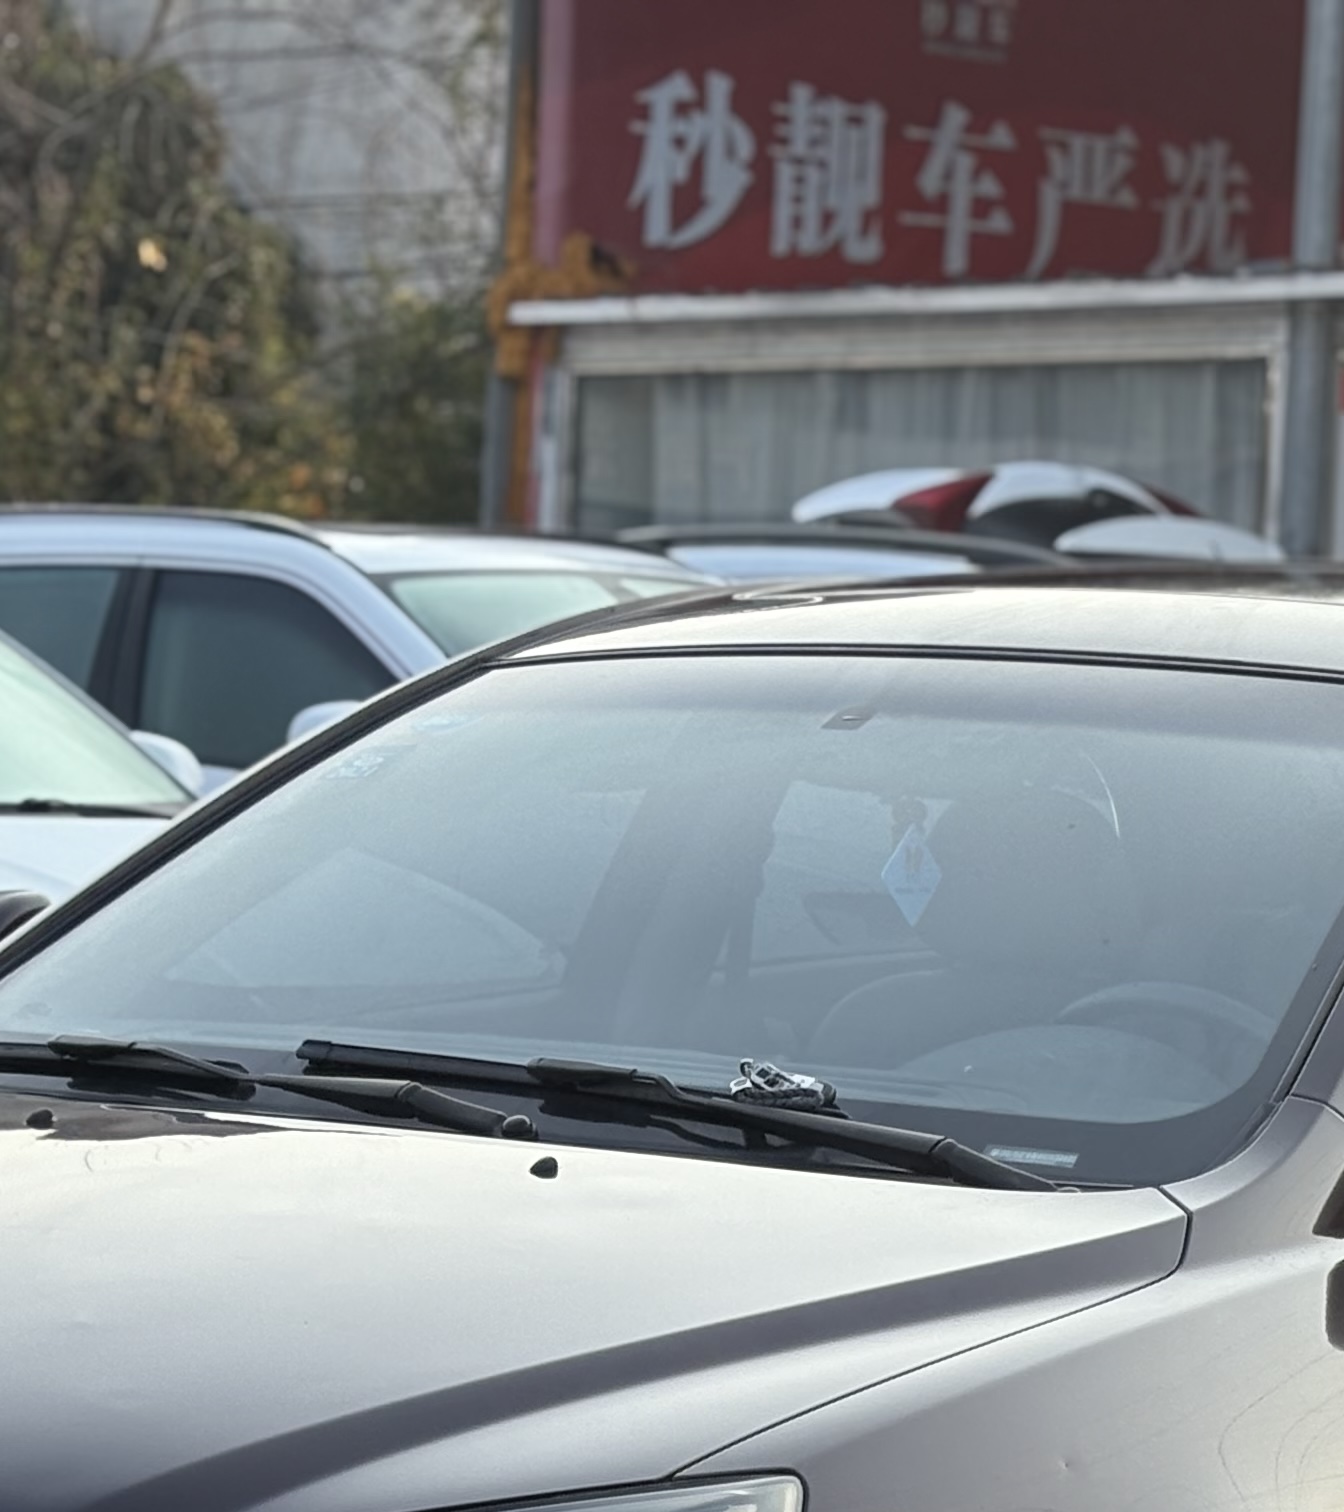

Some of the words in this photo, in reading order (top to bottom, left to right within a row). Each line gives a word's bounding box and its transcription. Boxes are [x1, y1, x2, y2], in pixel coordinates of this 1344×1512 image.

[628, 69, 1252, 281] 秒靓车严选
